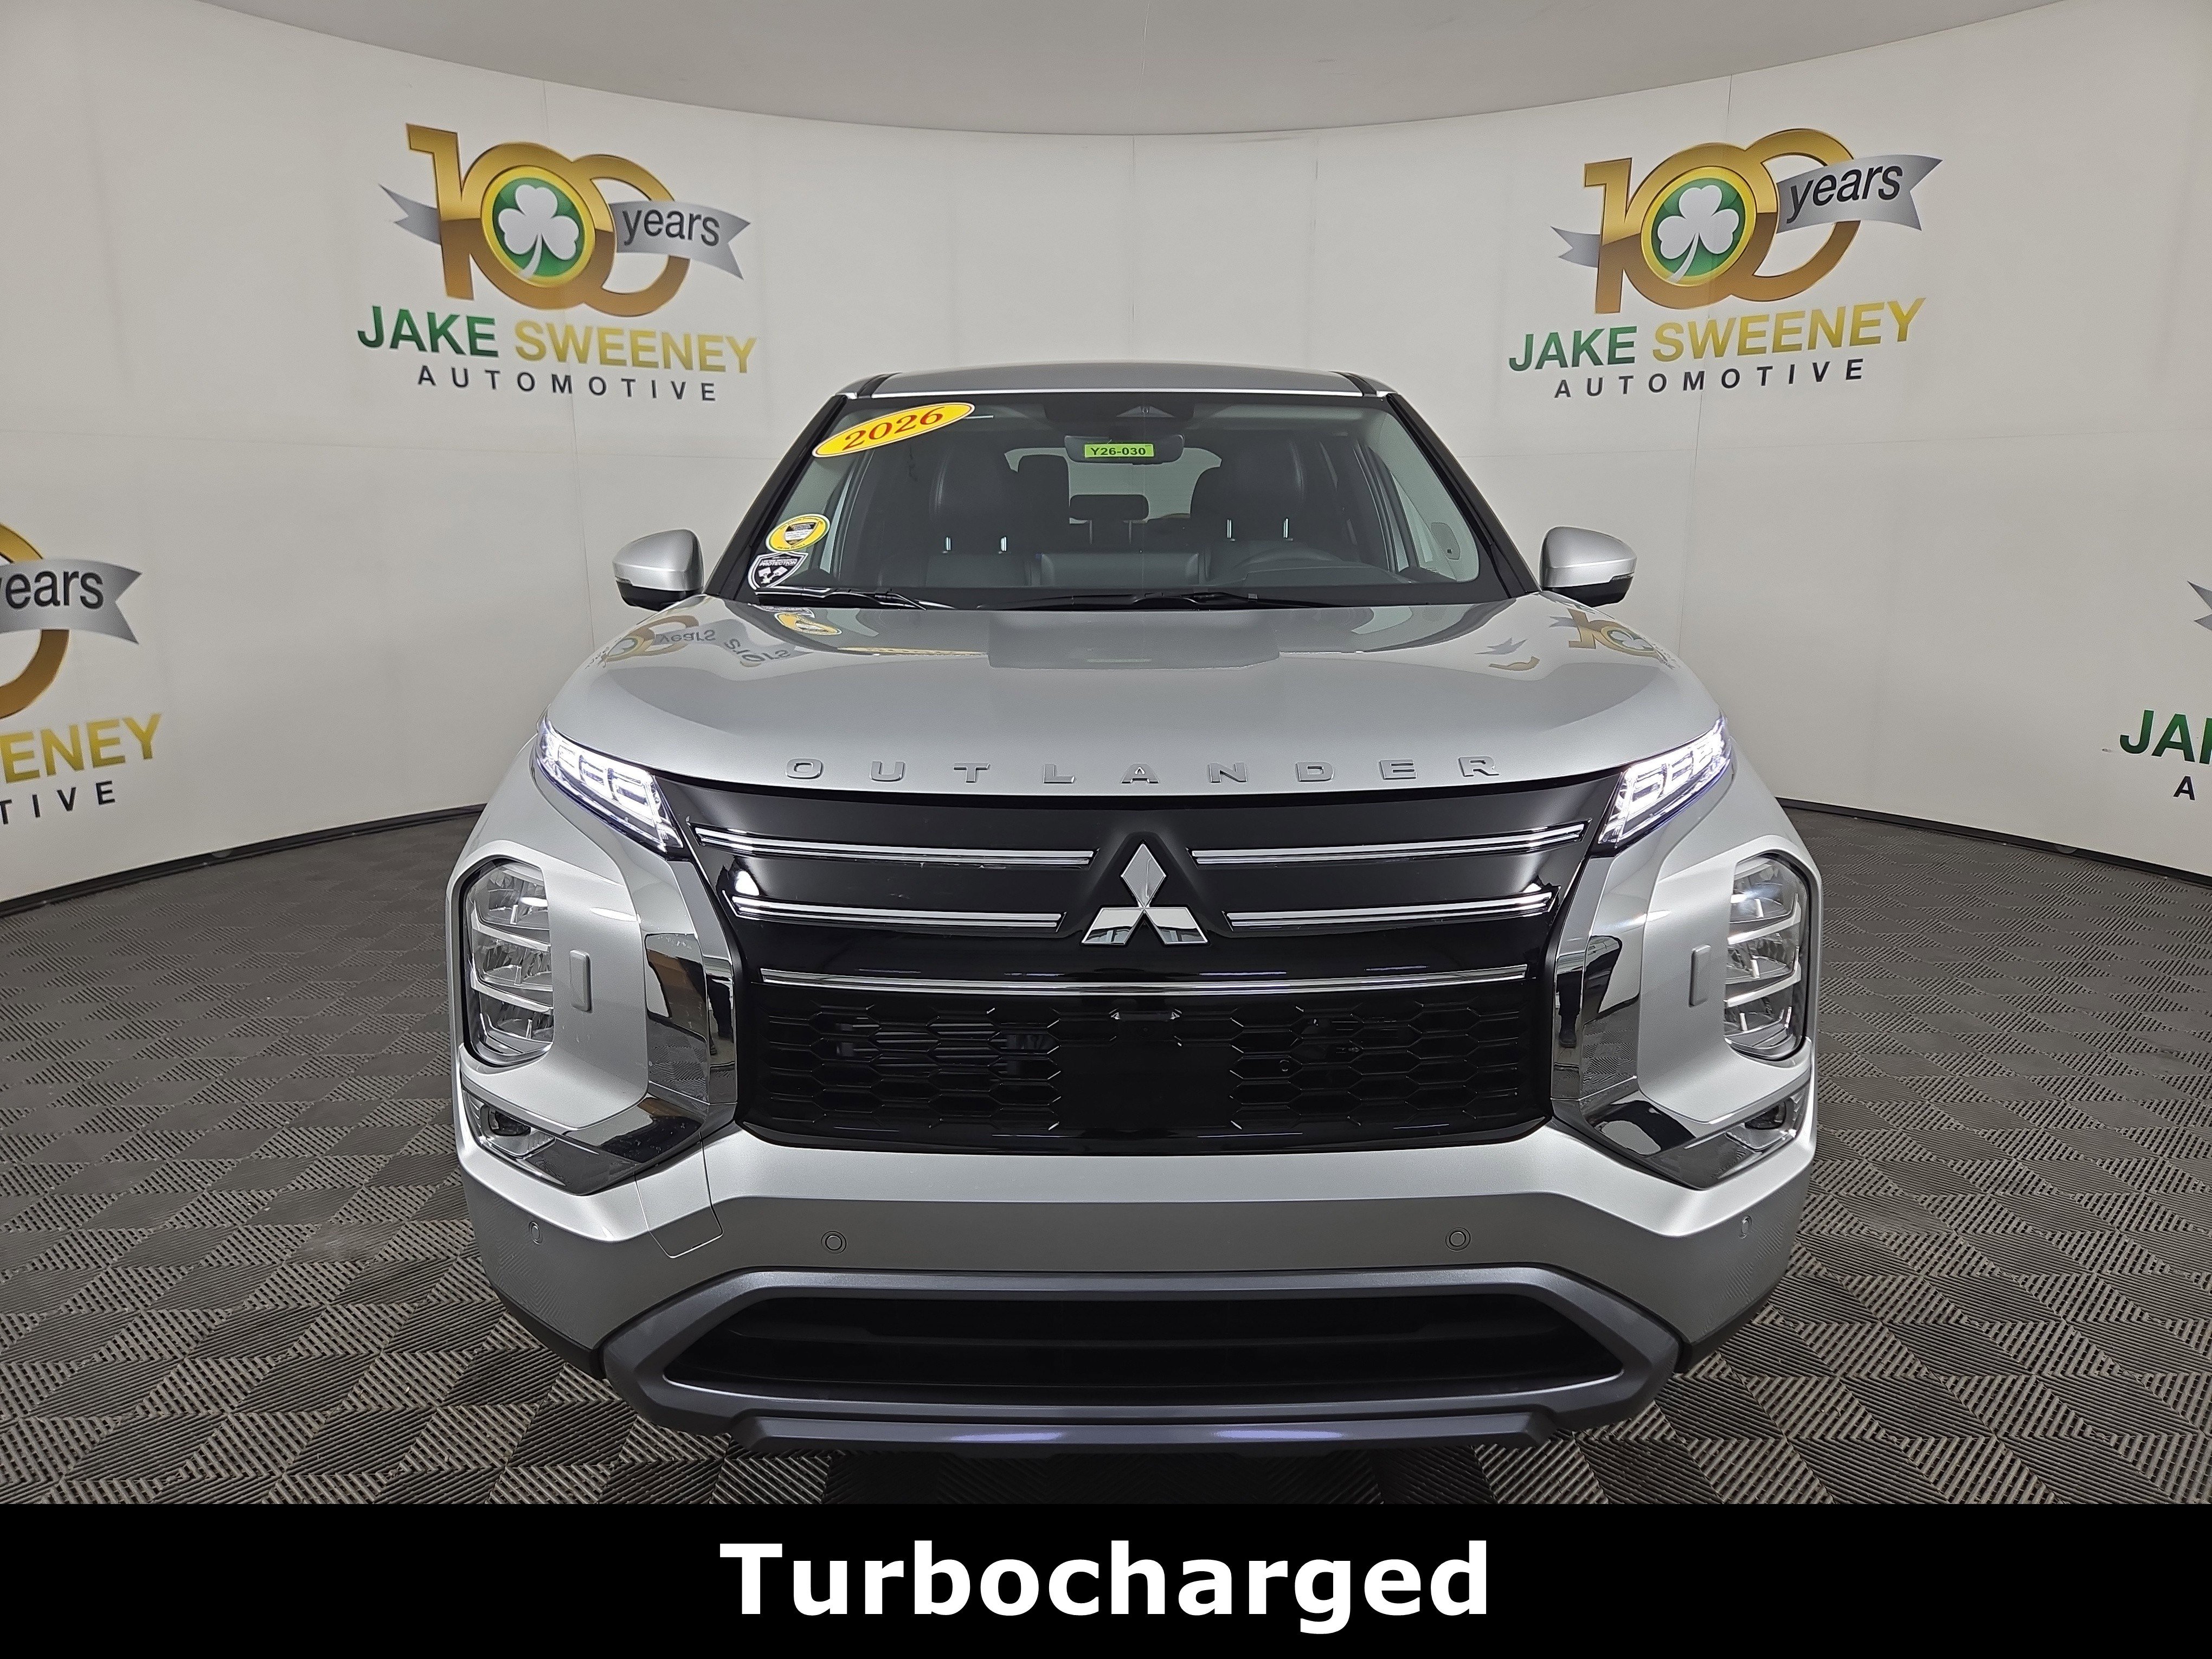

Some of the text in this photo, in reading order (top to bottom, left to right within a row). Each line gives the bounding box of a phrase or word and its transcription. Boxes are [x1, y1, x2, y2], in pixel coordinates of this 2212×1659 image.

[1787, 164, 1903, 223] years
[406, 123, 691, 317] 100
[621, 207, 721, 247] years
[1584, 128, 1861, 314] 100
[358, 305, 757, 374] JAKE SWEENEY
[1509, 298, 1926, 372] JAKE SWEENEY
[418, 365, 716, 401] AUTOMOTIVE
[1554, 358, 1865, 399] AUTOMOTIVE
[842, 407, 945, 451] 2026
[1090, 447, 1146, 455] Y26-030
[0, 570, 105, 609] ears
[0, 713, 162, 784] ENEY
[785, 755, 1502, 785] OUTLANDER
[0, 781, 115, 825] TIVE
[2173, 775, 2196, 801] A
